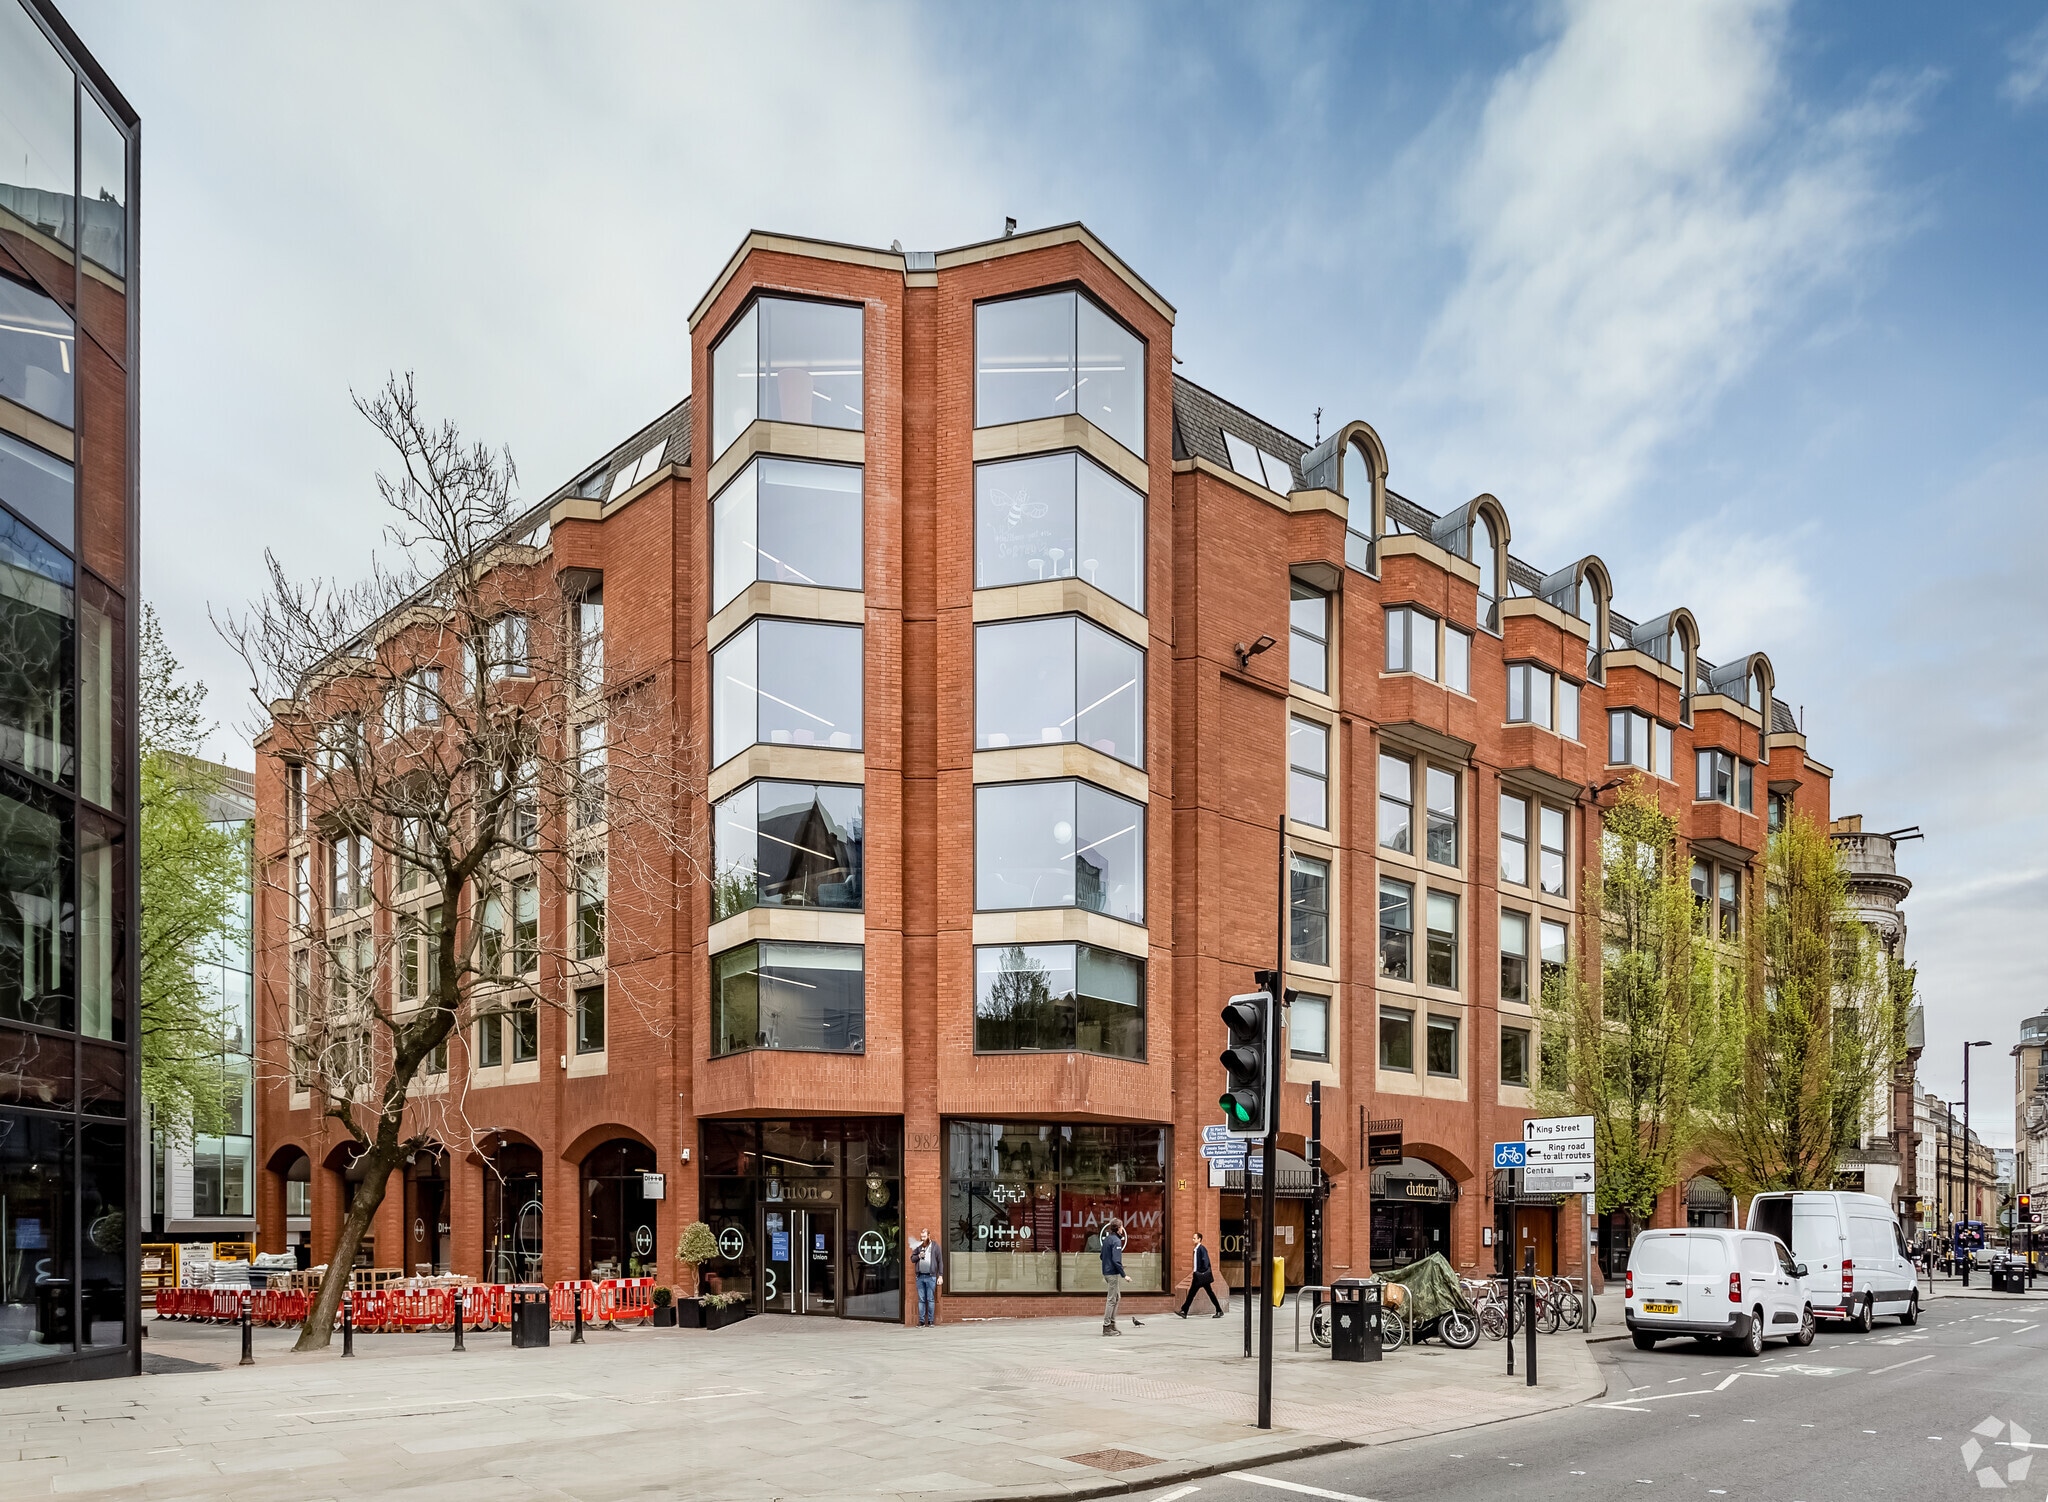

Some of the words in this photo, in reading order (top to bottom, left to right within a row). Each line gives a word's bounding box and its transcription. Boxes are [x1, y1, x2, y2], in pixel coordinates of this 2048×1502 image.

[1536, 1126, 1552, 1134] King
[1555, 1124, 1580, 1133] Street
[907, 1134, 939, 1149] 1982
[1568, 1142, 1586, 1150] road
[1553, 1152, 1563, 1160] all
[1565, 1151, 1591, 1160] routes
[1526, 1166, 1554, 1174] Central
